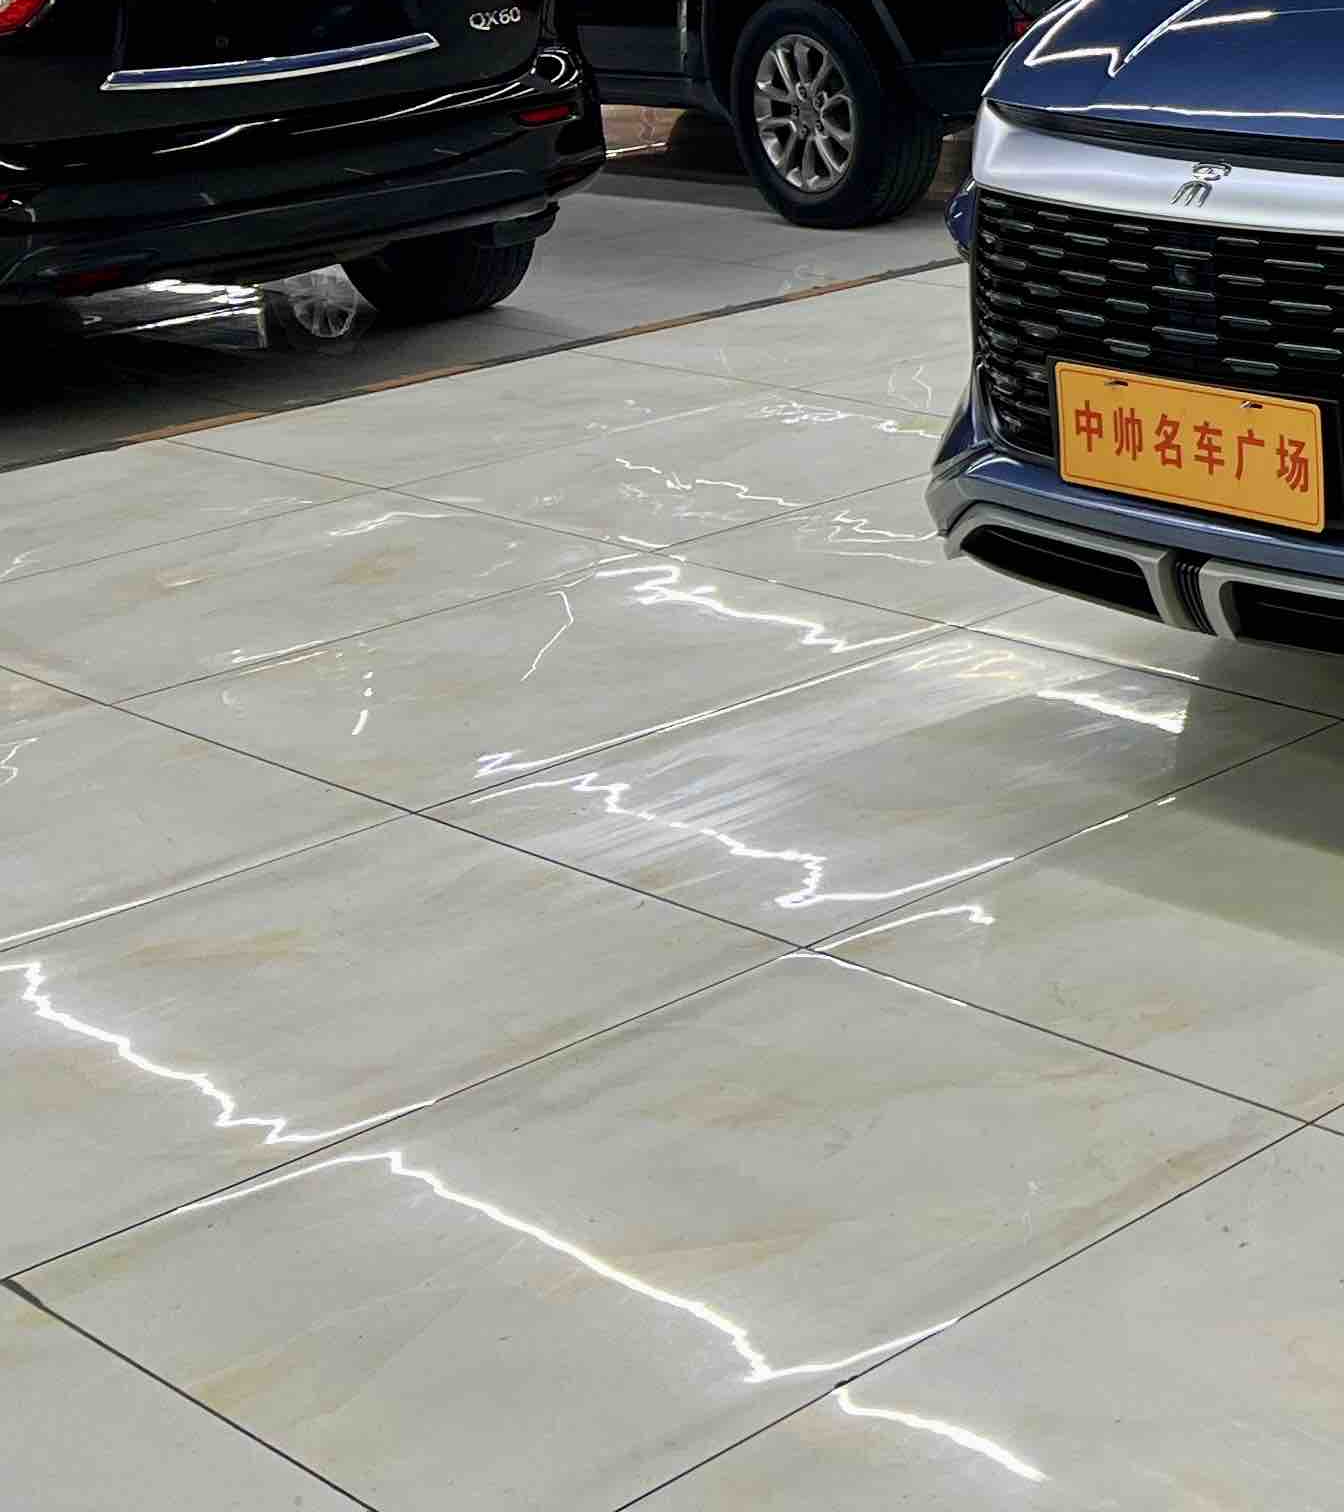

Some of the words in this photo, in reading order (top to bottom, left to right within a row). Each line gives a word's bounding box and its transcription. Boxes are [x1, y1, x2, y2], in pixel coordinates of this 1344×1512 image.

[468, 5, 522, 31] QX60
[1073, 399, 1311, 494] 中帅名车广场
